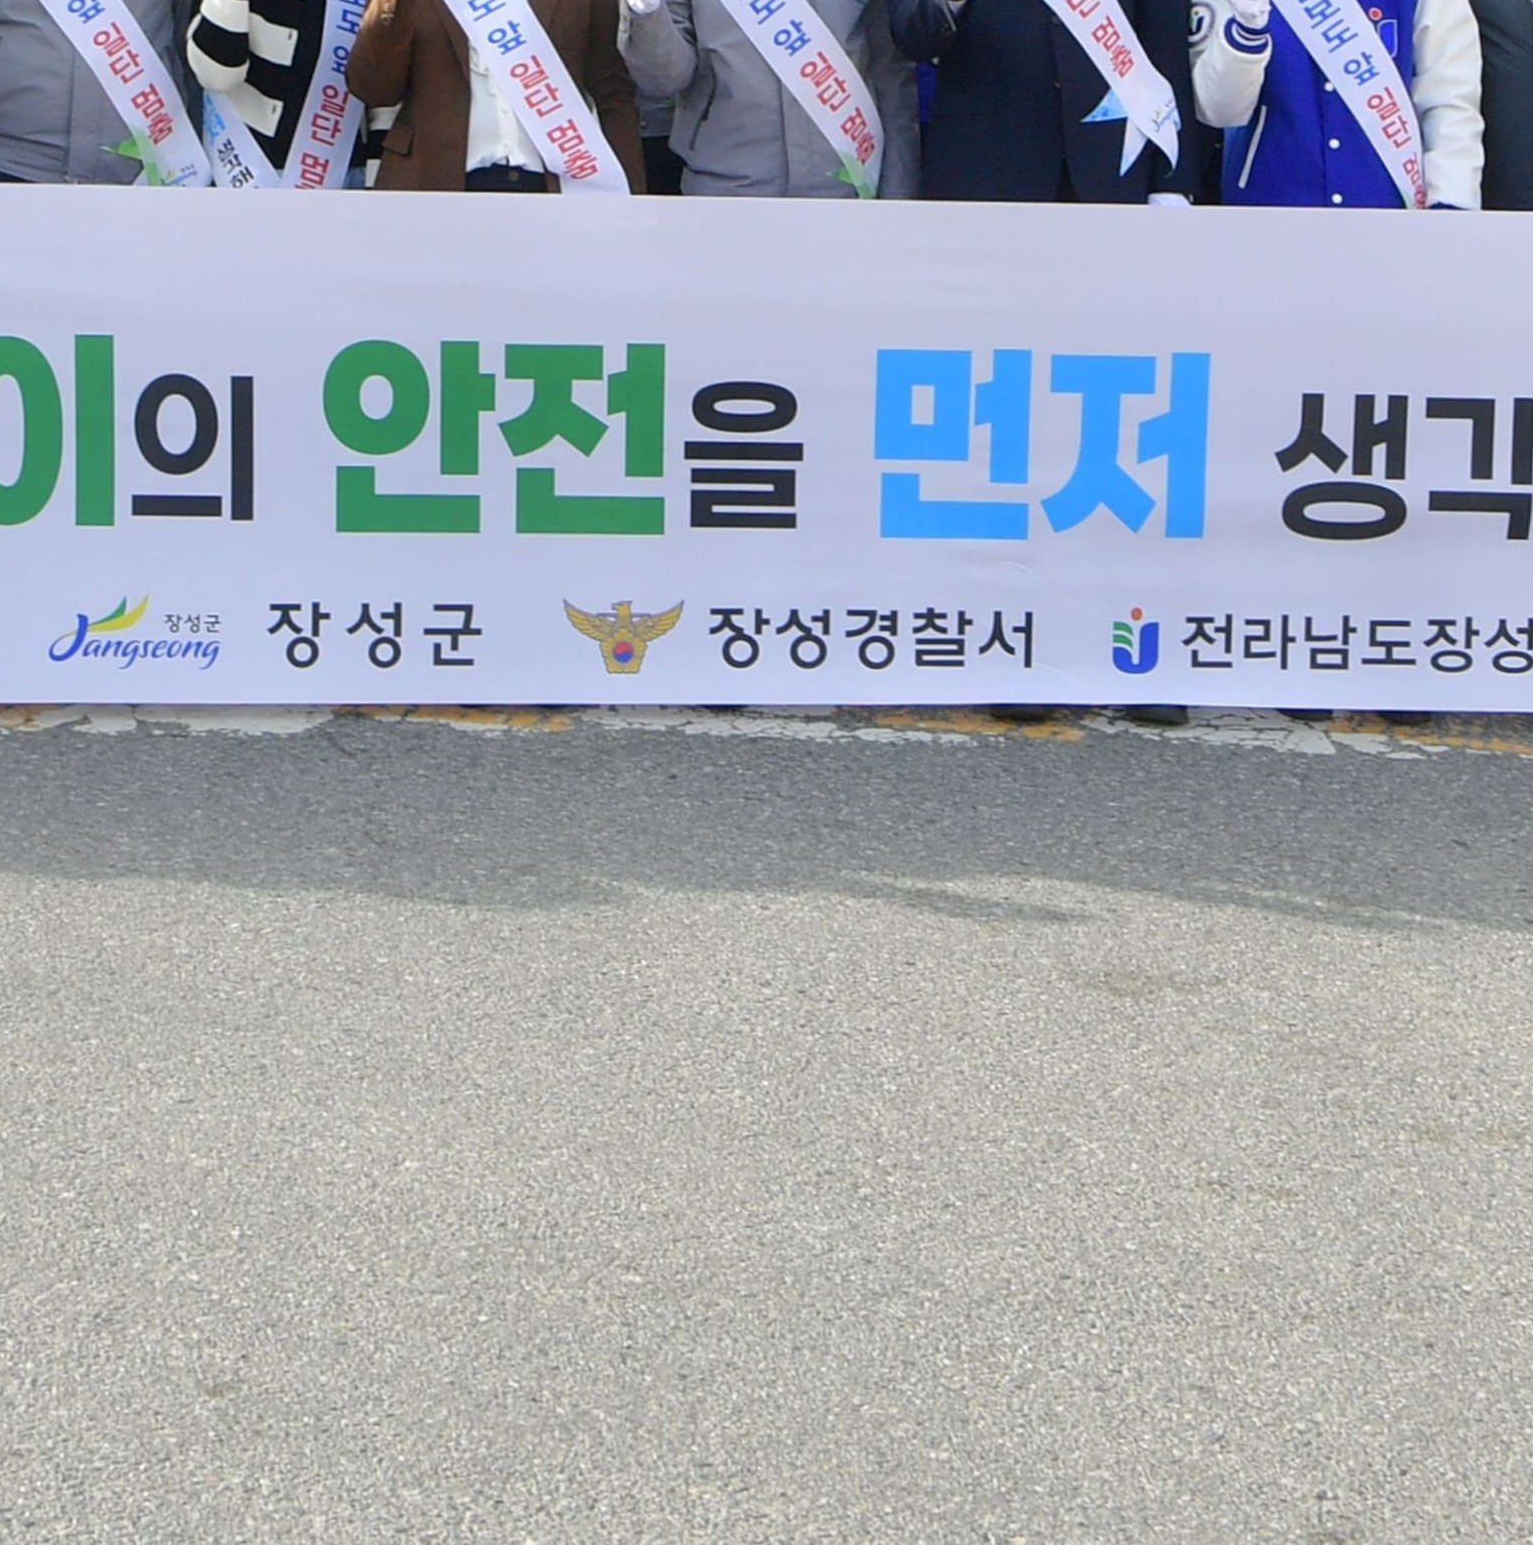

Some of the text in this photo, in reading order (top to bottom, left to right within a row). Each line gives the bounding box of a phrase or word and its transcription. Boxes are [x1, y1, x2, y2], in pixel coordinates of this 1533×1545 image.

[1091, 15, 1135, 79] 멈춤
[93, 21, 145, 85] 일단
[131, 84, 174, 146] 멈춤
[311, 84, 350, 147] 일단
[488, 20, 526, 55] 앞
[510, 54, 564, 118] 일단
[546, 118, 600, 181] 멈춤
[773, 19, 811, 56] 앞
[800, 51, 852, 112] 일단
[840, 107, 875, 166] 멈춤
[1344, 50, 1379, 87] 앞
[1366, 86, 1412, 150] 일단
[322, 339, 805, 536] 안전을
[873, 348, 1211, 540] 먼저
[48, 613, 220, 670] Jangseong
[164, 613, 221, 633] 장성군
[266, 602, 482, 668] 장성군
[708, 607, 1035, 671] 장성경찰서
